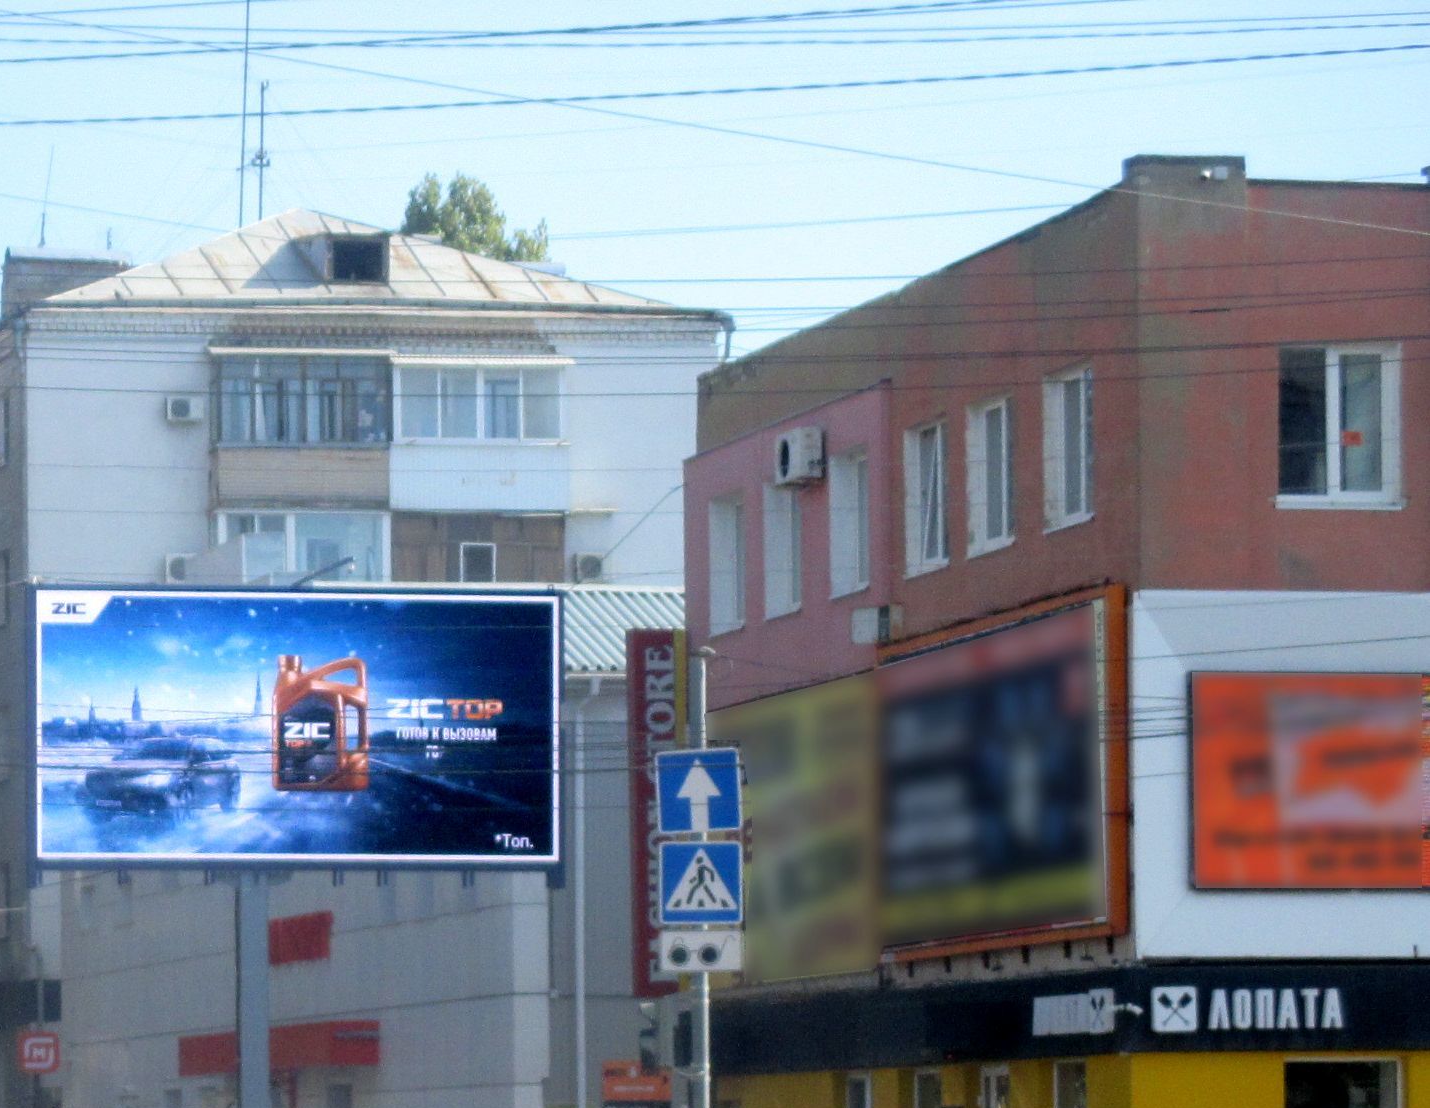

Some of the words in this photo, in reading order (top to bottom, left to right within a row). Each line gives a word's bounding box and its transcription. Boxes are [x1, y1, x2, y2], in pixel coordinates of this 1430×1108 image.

[51, 602, 87, 615] ZIC
[387, 698, 443, 719] ZIC
[446, 698, 503, 719] TOP
[284, 722, 330, 738] ZIC
[396, 727, 429, 740] ГОТОВ
[432, 727, 440, 740] К
[443, 727, 497, 741] ВЫЗОВАМ
[1208, 988, 1344, 1029] ЛОПАТА
